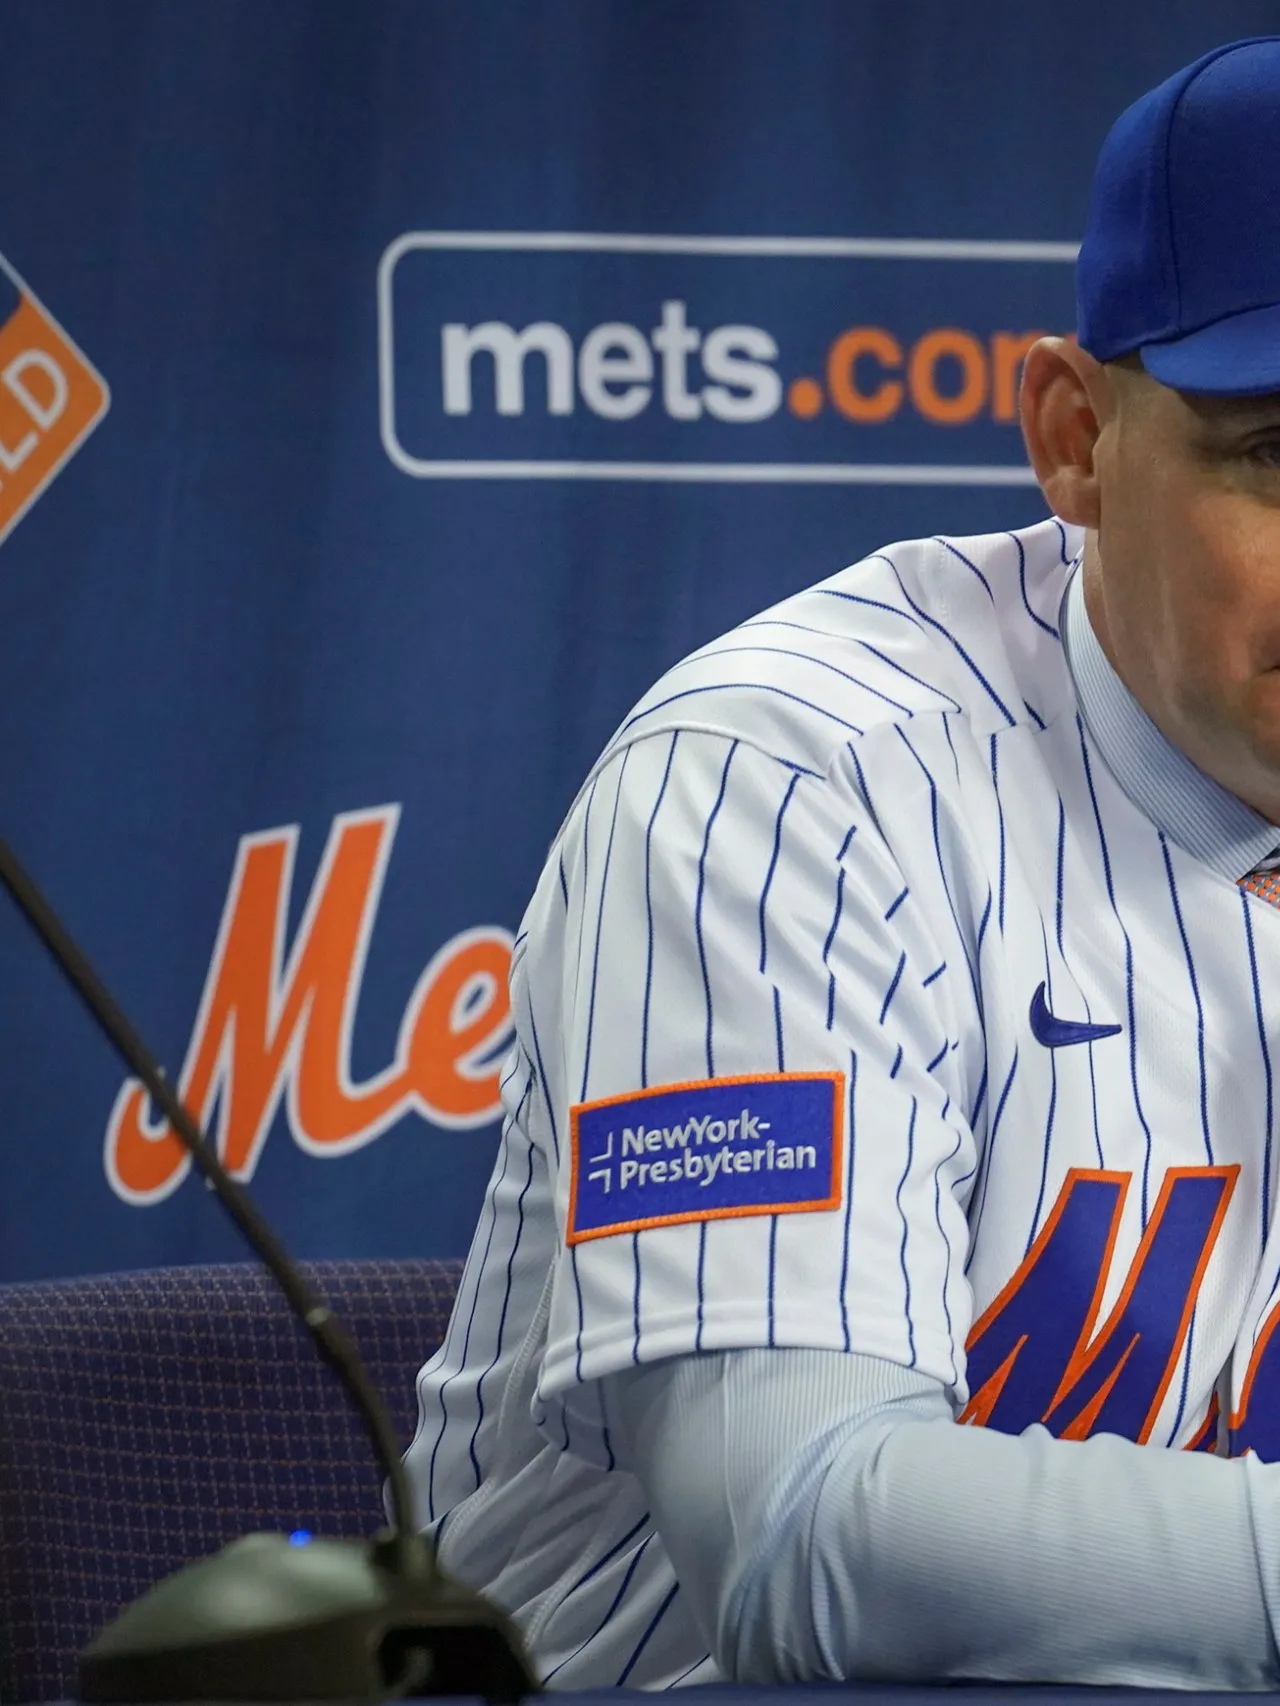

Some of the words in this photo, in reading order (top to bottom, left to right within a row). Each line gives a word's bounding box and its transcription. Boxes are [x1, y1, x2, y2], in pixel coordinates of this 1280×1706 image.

[104, 802, 516, 1207] Me
[621, 1108, 771, 1157] NewYork-
[620, 1140, 816, 1190] Presbyterian
